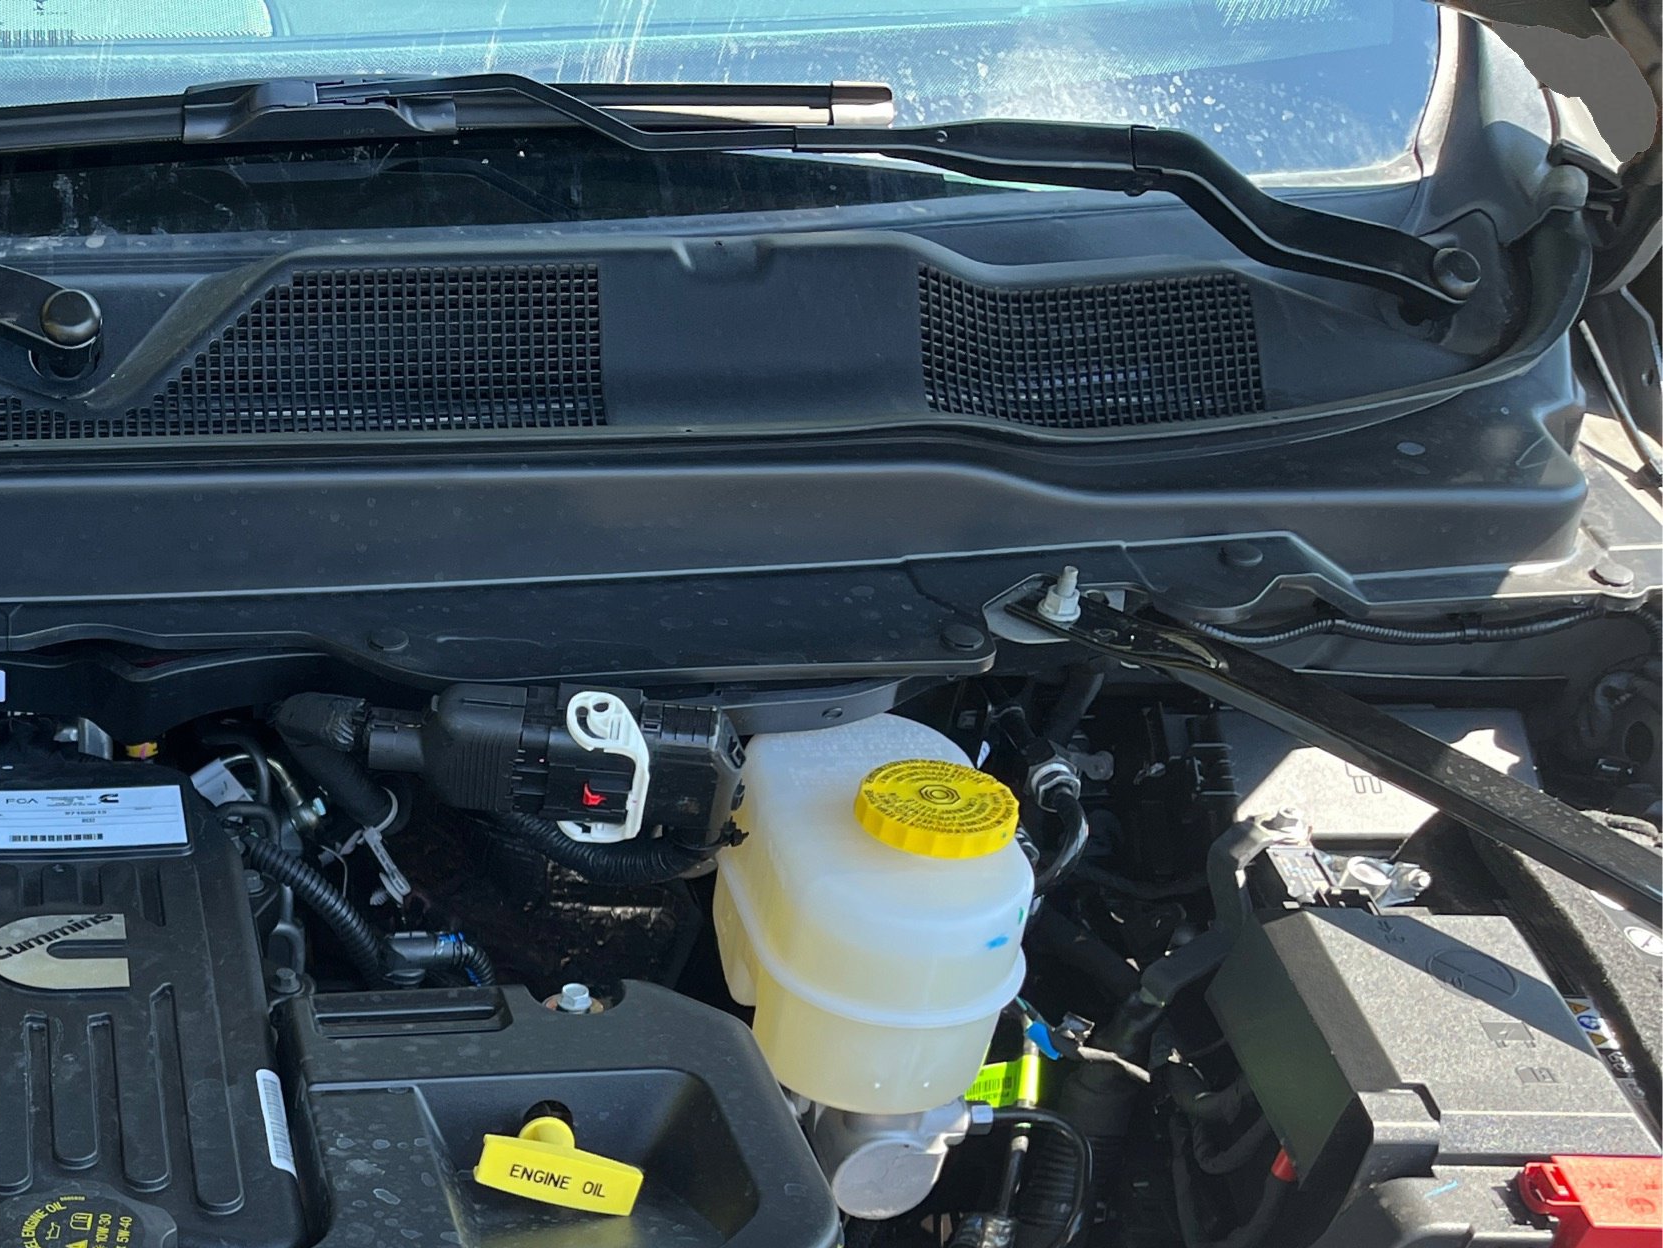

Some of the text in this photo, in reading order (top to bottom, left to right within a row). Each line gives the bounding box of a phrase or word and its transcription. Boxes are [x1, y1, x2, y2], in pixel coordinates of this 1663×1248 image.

[509, 1163, 606, 1198] ENGINE OIL
[21, 1208, 49, 1238] ENGINE
[45, 1201, 67, 1214] OIL
[96, 1213, 112, 1243] 10W-30
[117, 1216, 133, 1243] 5W-40
